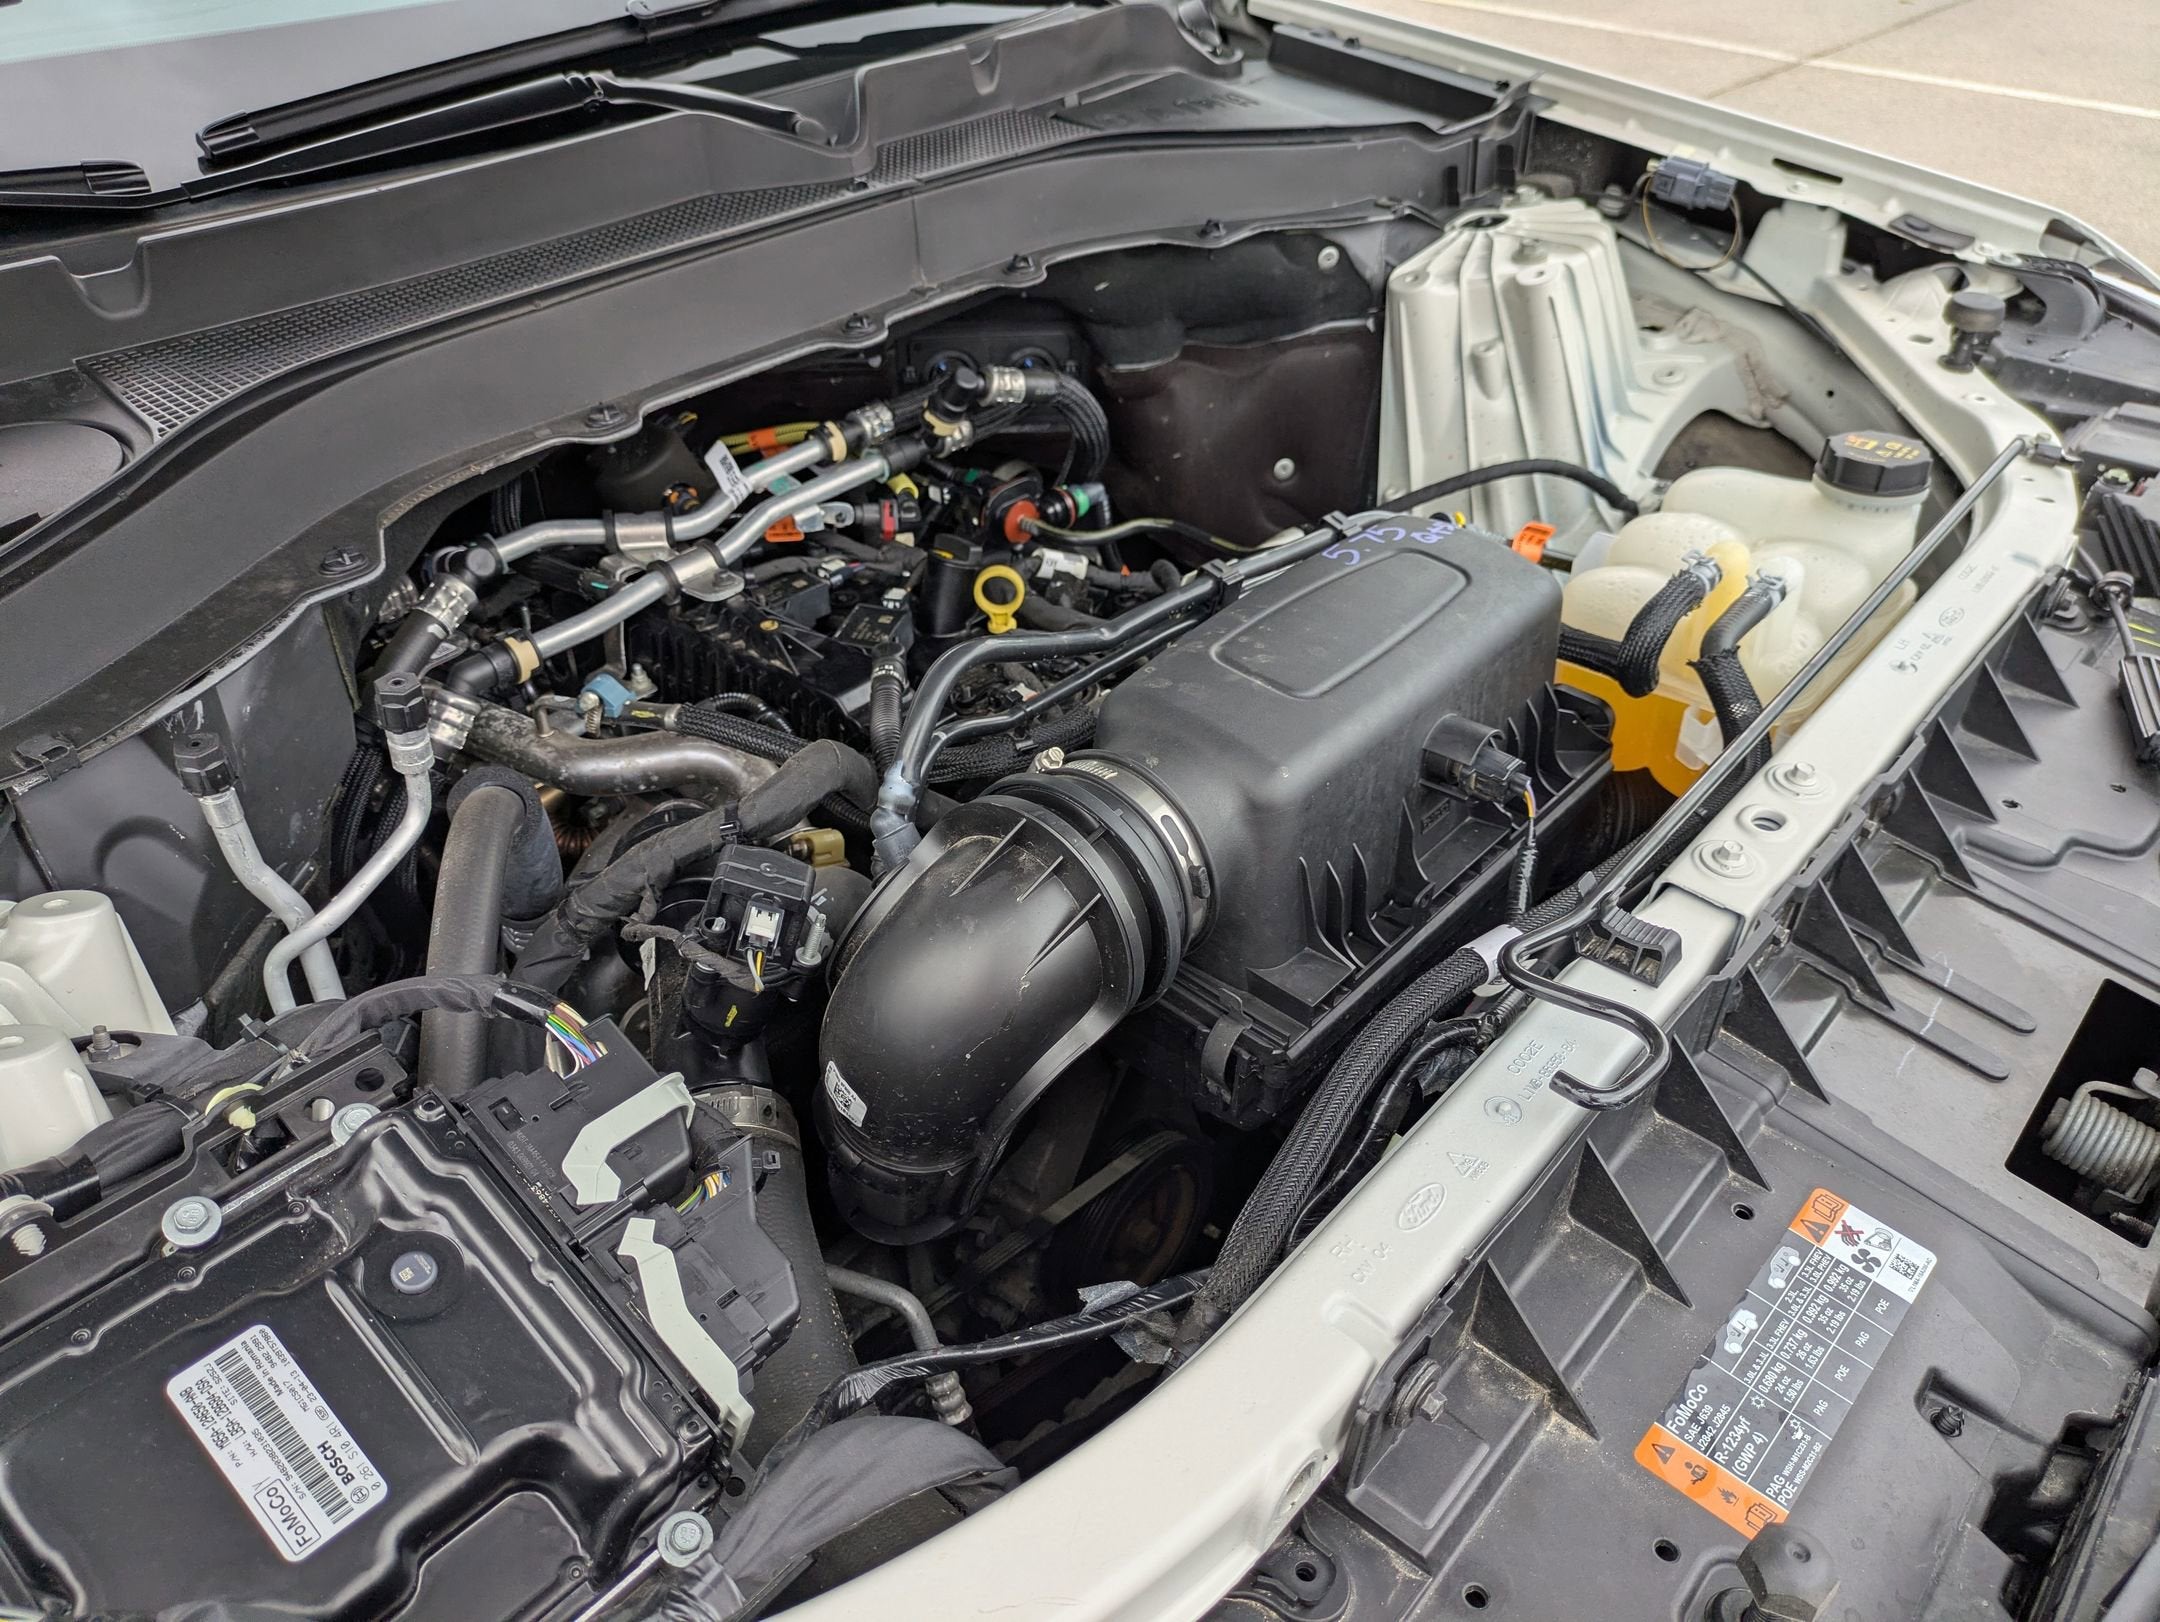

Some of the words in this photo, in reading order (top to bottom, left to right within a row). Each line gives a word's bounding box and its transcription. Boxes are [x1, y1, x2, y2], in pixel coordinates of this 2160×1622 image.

[1801, 1265, 1815, 1278] 3.3L
[1809, 1248, 1823, 1266] FHEV
[1809, 1270, 1823, 1283] 3.0L
[1816, 1253, 1831, 1271] PHEV
[1823, 1271, 1841, 1292] 0.992
[1834, 1263, 1849, 1274] kg
[1838, 1282, 1849, 1293] 35
[1844, 1276, 1854, 1285] oz
[1787, 1303, 1801, 1316] 3.0L
[1798, 1286, 1812, 1299] 3.3L
[1846, 1288, 1860, 1302] 2.19
[1853, 1279, 1866, 1290] lbs
[1802, 1302, 1821, 1323] 0.992
[1813, 1293, 1829, 1305] kg
[1817, 1313, 1828, 1324] 35
[1824, 1307, 1834, 1316] oz
[1874, 1298, 1889, 1314] POE
[1765, 1336, 1780, 1349] 3.3L
[1774, 1318, 1789, 1337] FHEV
[1825, 1319, 1840, 1334] 2.19
[1833, 1310, 1846, 1322] lbs
[1779, 1336, 1798, 1359] 0.737
[1791, 1328, 1808, 1340] kg
[1795, 1349, 1807, 1360] 26
[1802, 1341, 1813, 1351] oz
[1854, 1331, 1869, 1348] PAG
[240, 1340, 264, 1370] Romania
[1751, 1363, 1761, 1371] &
[1755, 1351, 1769, 1365] 3.3L
[1804, 1354, 1818, 1369] 1.63
[1811, 1345, 1825, 1357] lbs
[261, 1368, 270, 1378] in
[1743, 1370, 1757, 1384] 3.0L
[1758, 1370, 1777, 1393] 0.680
[1770, 1361, 1786, 1374] kg
[1774, 1382, 1785, 1394] 24
[1781, 1375, 1791, 1385] oz
[1834, 1364, 1850, 1381] POE
[219, 1385, 238, 1406] SITE:
[267, 1376, 283, 1396] Made
[289, 1369, 317, 1402] 23-04-13
[1783, 1388, 1797, 1403] 1.50
[1790, 1378, 1804, 1391] lbs
[1666, 1384, 1707, 1434] FoMoCo
[1812, 1399, 1828, 1416] PAG
[1684, 1422, 1701, 1442] SAE
[1697, 1404, 1713, 1424] J639
[1697, 1425, 1717, 1451] J2842
[1712, 1403, 1730, 1428] J2845
[242, 1439, 257, 1457] H/W:
[1714, 1415, 1750, 1463] R-1234yf
[227, 1449, 243, 1468] P/N:
[317, 1440, 355, 1485] BOSCH
[1731, 1442, 1756, 1477] (GWP
[1751, 1431, 1768, 1445] 4)
[356, 1462, 374, 1480] 261
[291, 1482, 306, 1500] S/N:
[370, 1481, 381, 1491] 0
[1766, 1474, 1785, 1498] PAG
[1777, 1481, 1797, 1506] POE
[266, 1486, 312, 1547] FoMoCo
